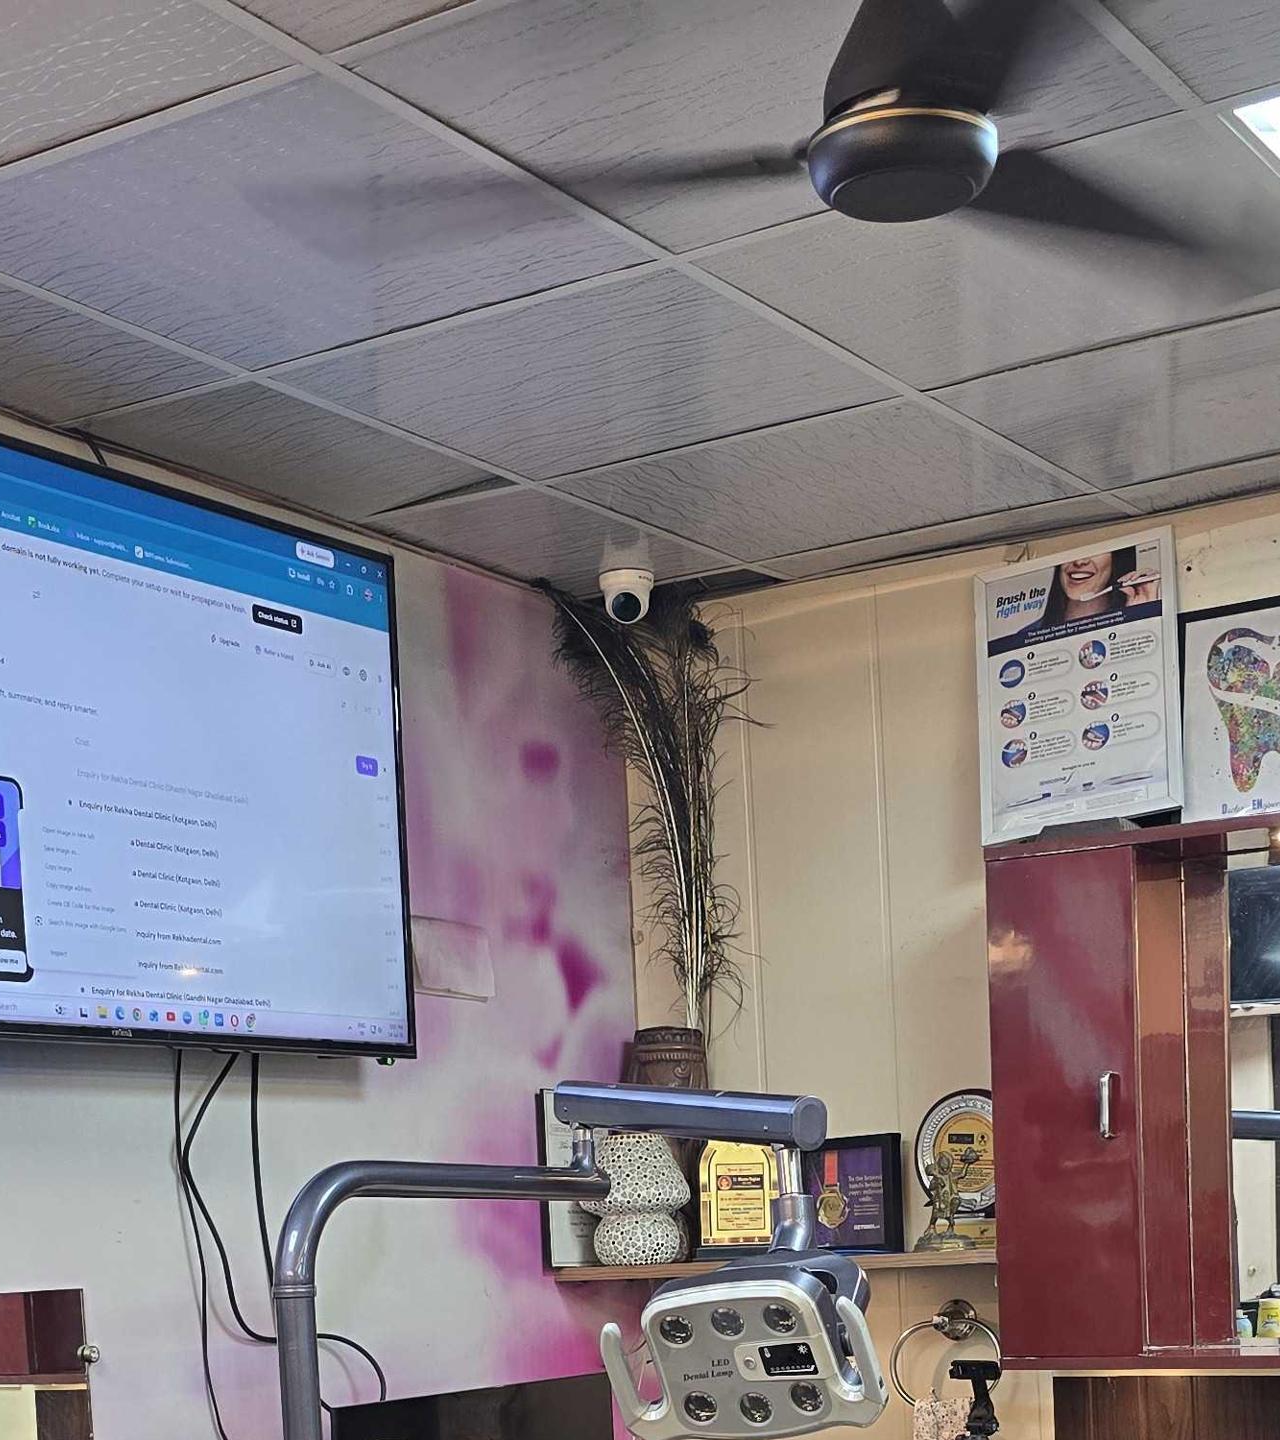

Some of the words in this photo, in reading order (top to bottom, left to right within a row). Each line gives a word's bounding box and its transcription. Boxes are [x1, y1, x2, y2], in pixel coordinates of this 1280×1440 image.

[996, 590, 1027, 608] Brush
[1029, 586, 1047, 599] the
[996, 604, 1021, 620] right
[1023, 598, 1046, 612] way
[78, 799, 103, 813] Enquiry
[134, 808, 154, 820] Dental
[154, 811, 171, 823] Clinic
[91, 986, 116, 997] Enquiry
[711, 1359, 730, 1367] LED
[683, 1370, 709, 1382] Dental
[711, 1369, 733, 1378] Lamp
